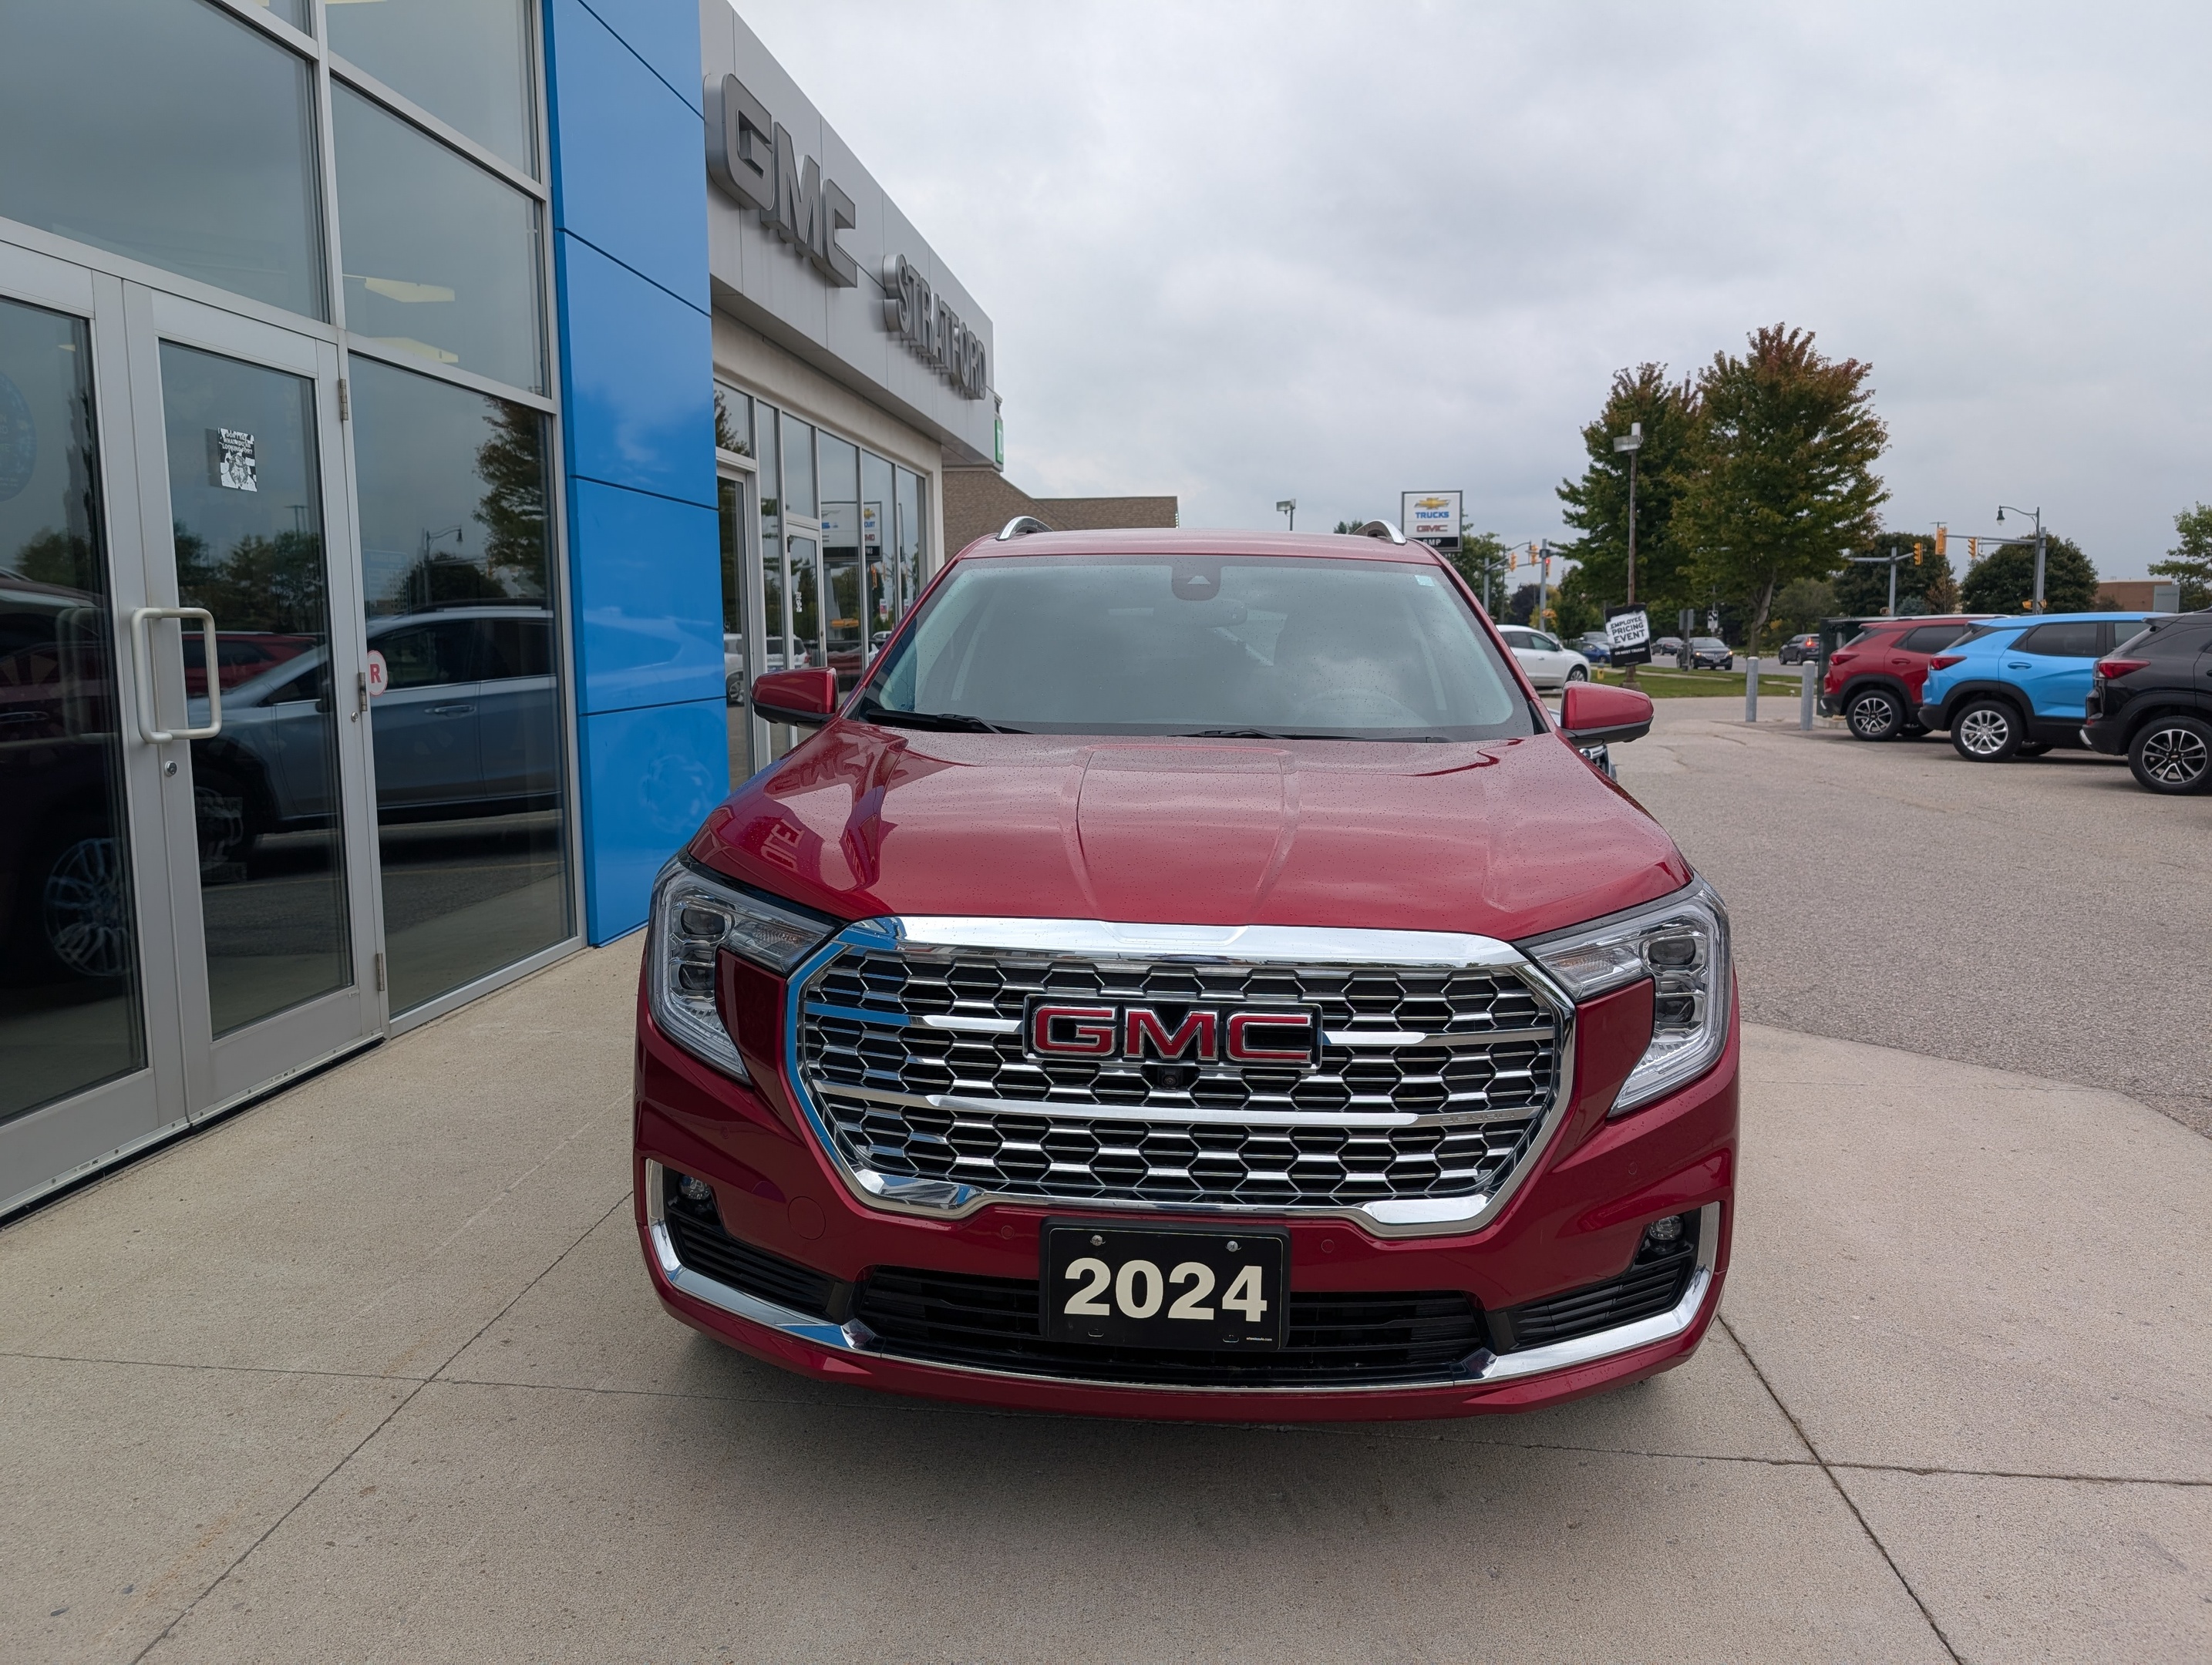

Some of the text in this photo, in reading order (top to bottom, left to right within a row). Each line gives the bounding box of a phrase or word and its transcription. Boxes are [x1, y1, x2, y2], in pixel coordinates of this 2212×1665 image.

[704, 73, 857, 288] GMC
[883, 254, 987, 400] STRATFORD
[1416, 524, 1448, 533] GMC
[1610, 616, 1642, 629] EMPLOYEE
[1611, 622, 1644, 635] PRICING
[1614, 629, 1645, 644] EVENT
[370, 664, 382, 683] R
[1032, 1004, 1312, 1062] GMC
[1439, 1112, 1514, 1124] DENALI
[1064, 1257, 1268, 1322] 2024
